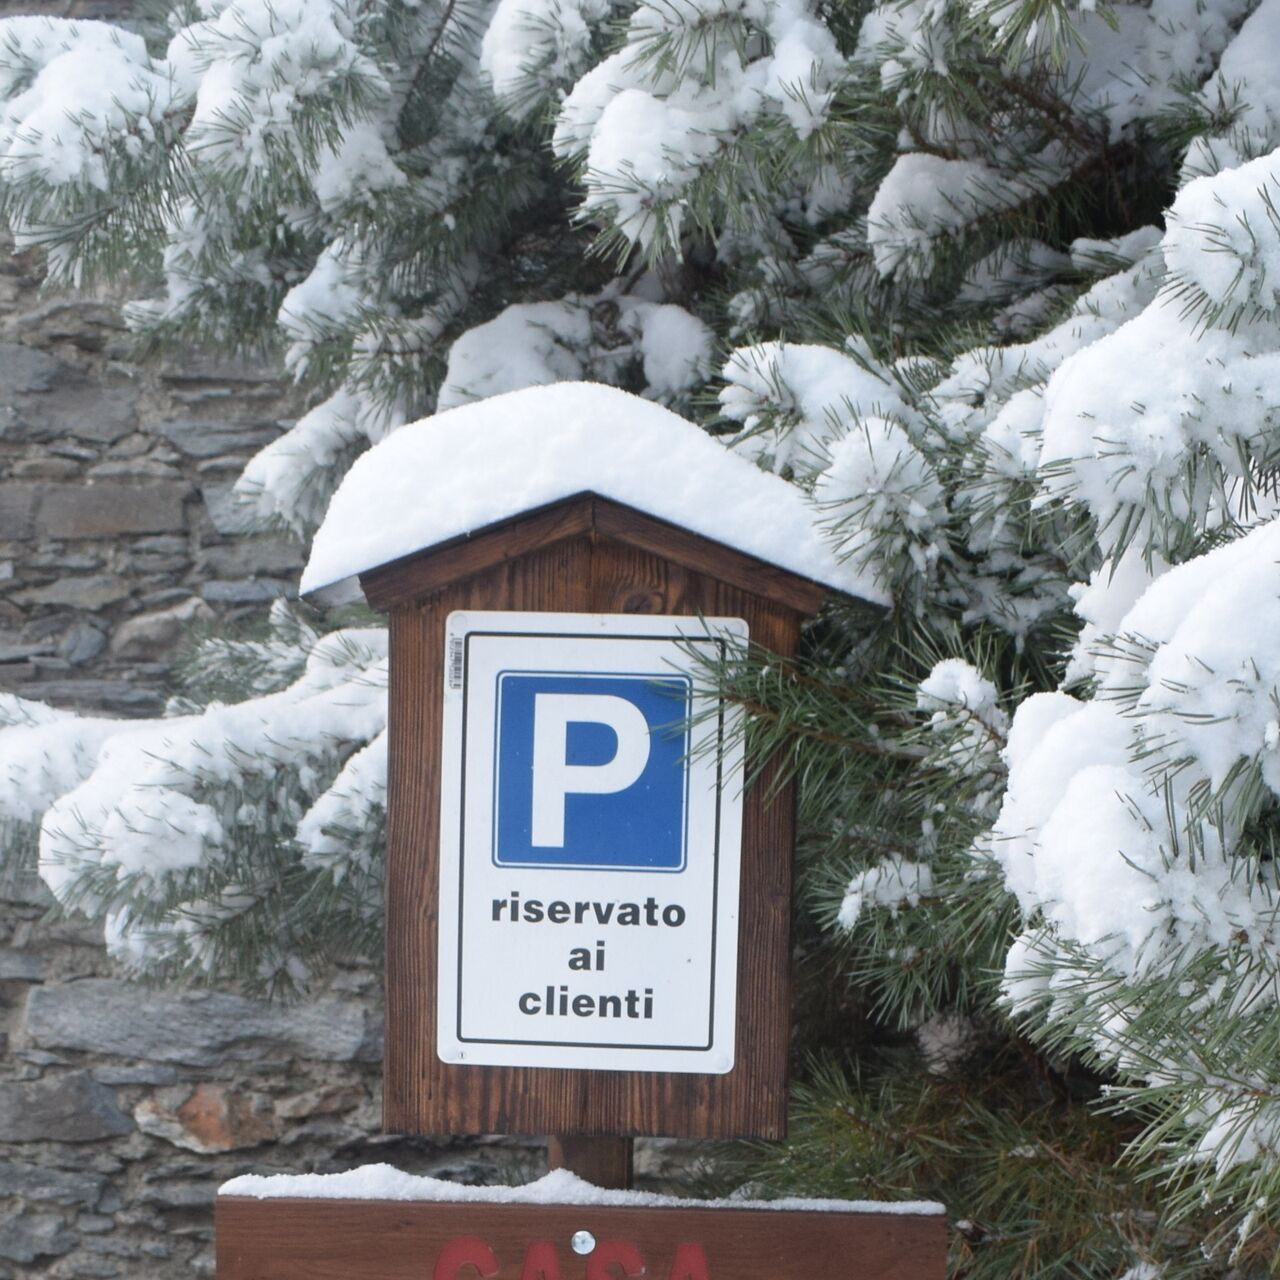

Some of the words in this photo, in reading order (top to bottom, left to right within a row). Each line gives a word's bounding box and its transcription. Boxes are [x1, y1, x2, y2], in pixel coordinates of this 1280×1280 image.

[531, 692, 652, 848] P
[491, 891, 686, 928] riservato
[567, 940, 606, 972] ai
[518, 986, 655, 1019] clienti
